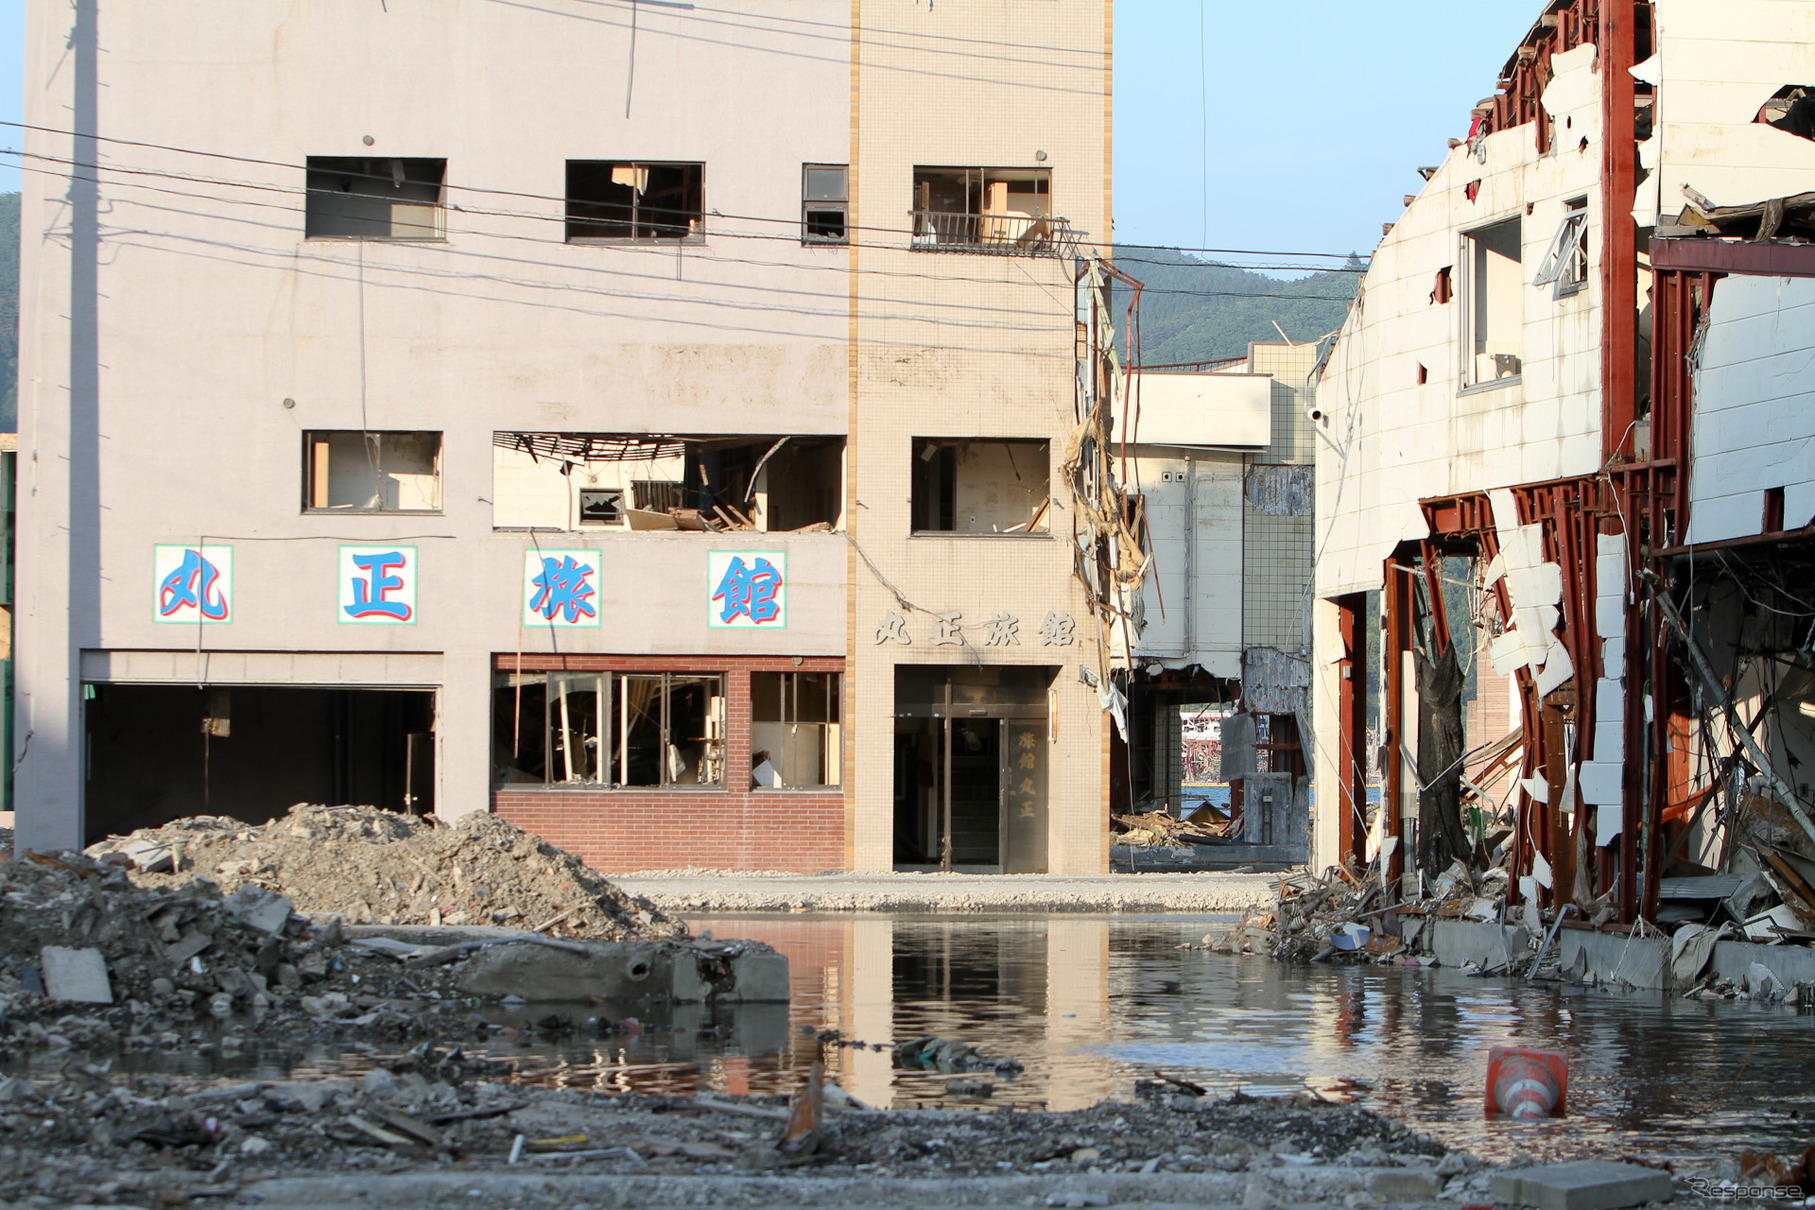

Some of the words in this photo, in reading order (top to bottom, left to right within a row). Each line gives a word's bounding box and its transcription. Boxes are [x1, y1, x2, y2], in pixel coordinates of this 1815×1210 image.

[160, 549, 782, 624] 丸正旅館
[876, 612, 1076, 646] 丸正旅館
[1018, 731, 1037, 819] 旅館丸正
